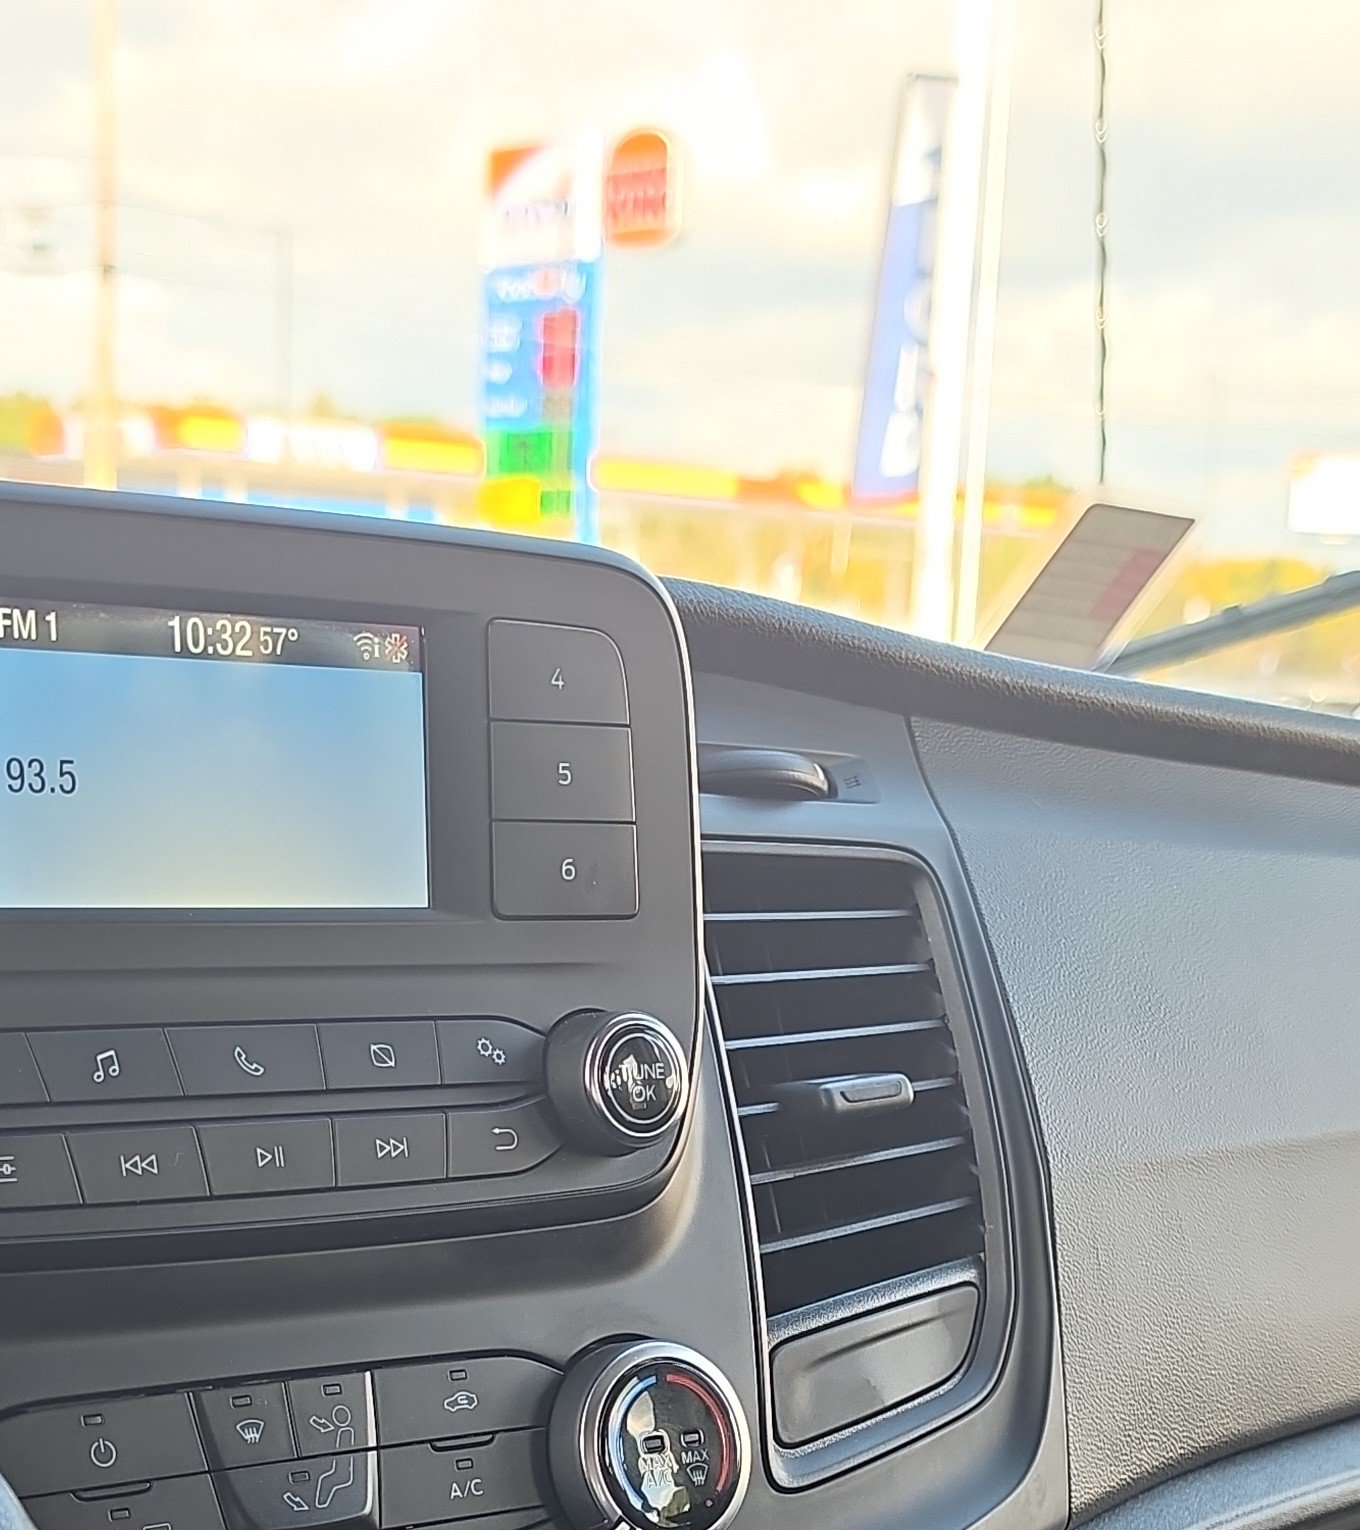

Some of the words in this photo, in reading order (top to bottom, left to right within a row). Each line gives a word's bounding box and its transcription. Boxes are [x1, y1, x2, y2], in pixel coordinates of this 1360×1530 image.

[45, 611, 58, 642] 1
[167, 614, 253, 656] 10:32
[550, 667, 565, 690] 4
[5, 756, 77, 796] 93.5
[557, 762, 572, 786] 5
[560, 857, 576, 881] 6
[619, 1062, 665, 1081] TUNE
[632, 1083, 657, 1102] OK
[681, 1448, 710, 1465] MAX
[450, 1479, 484, 1499] A/C
